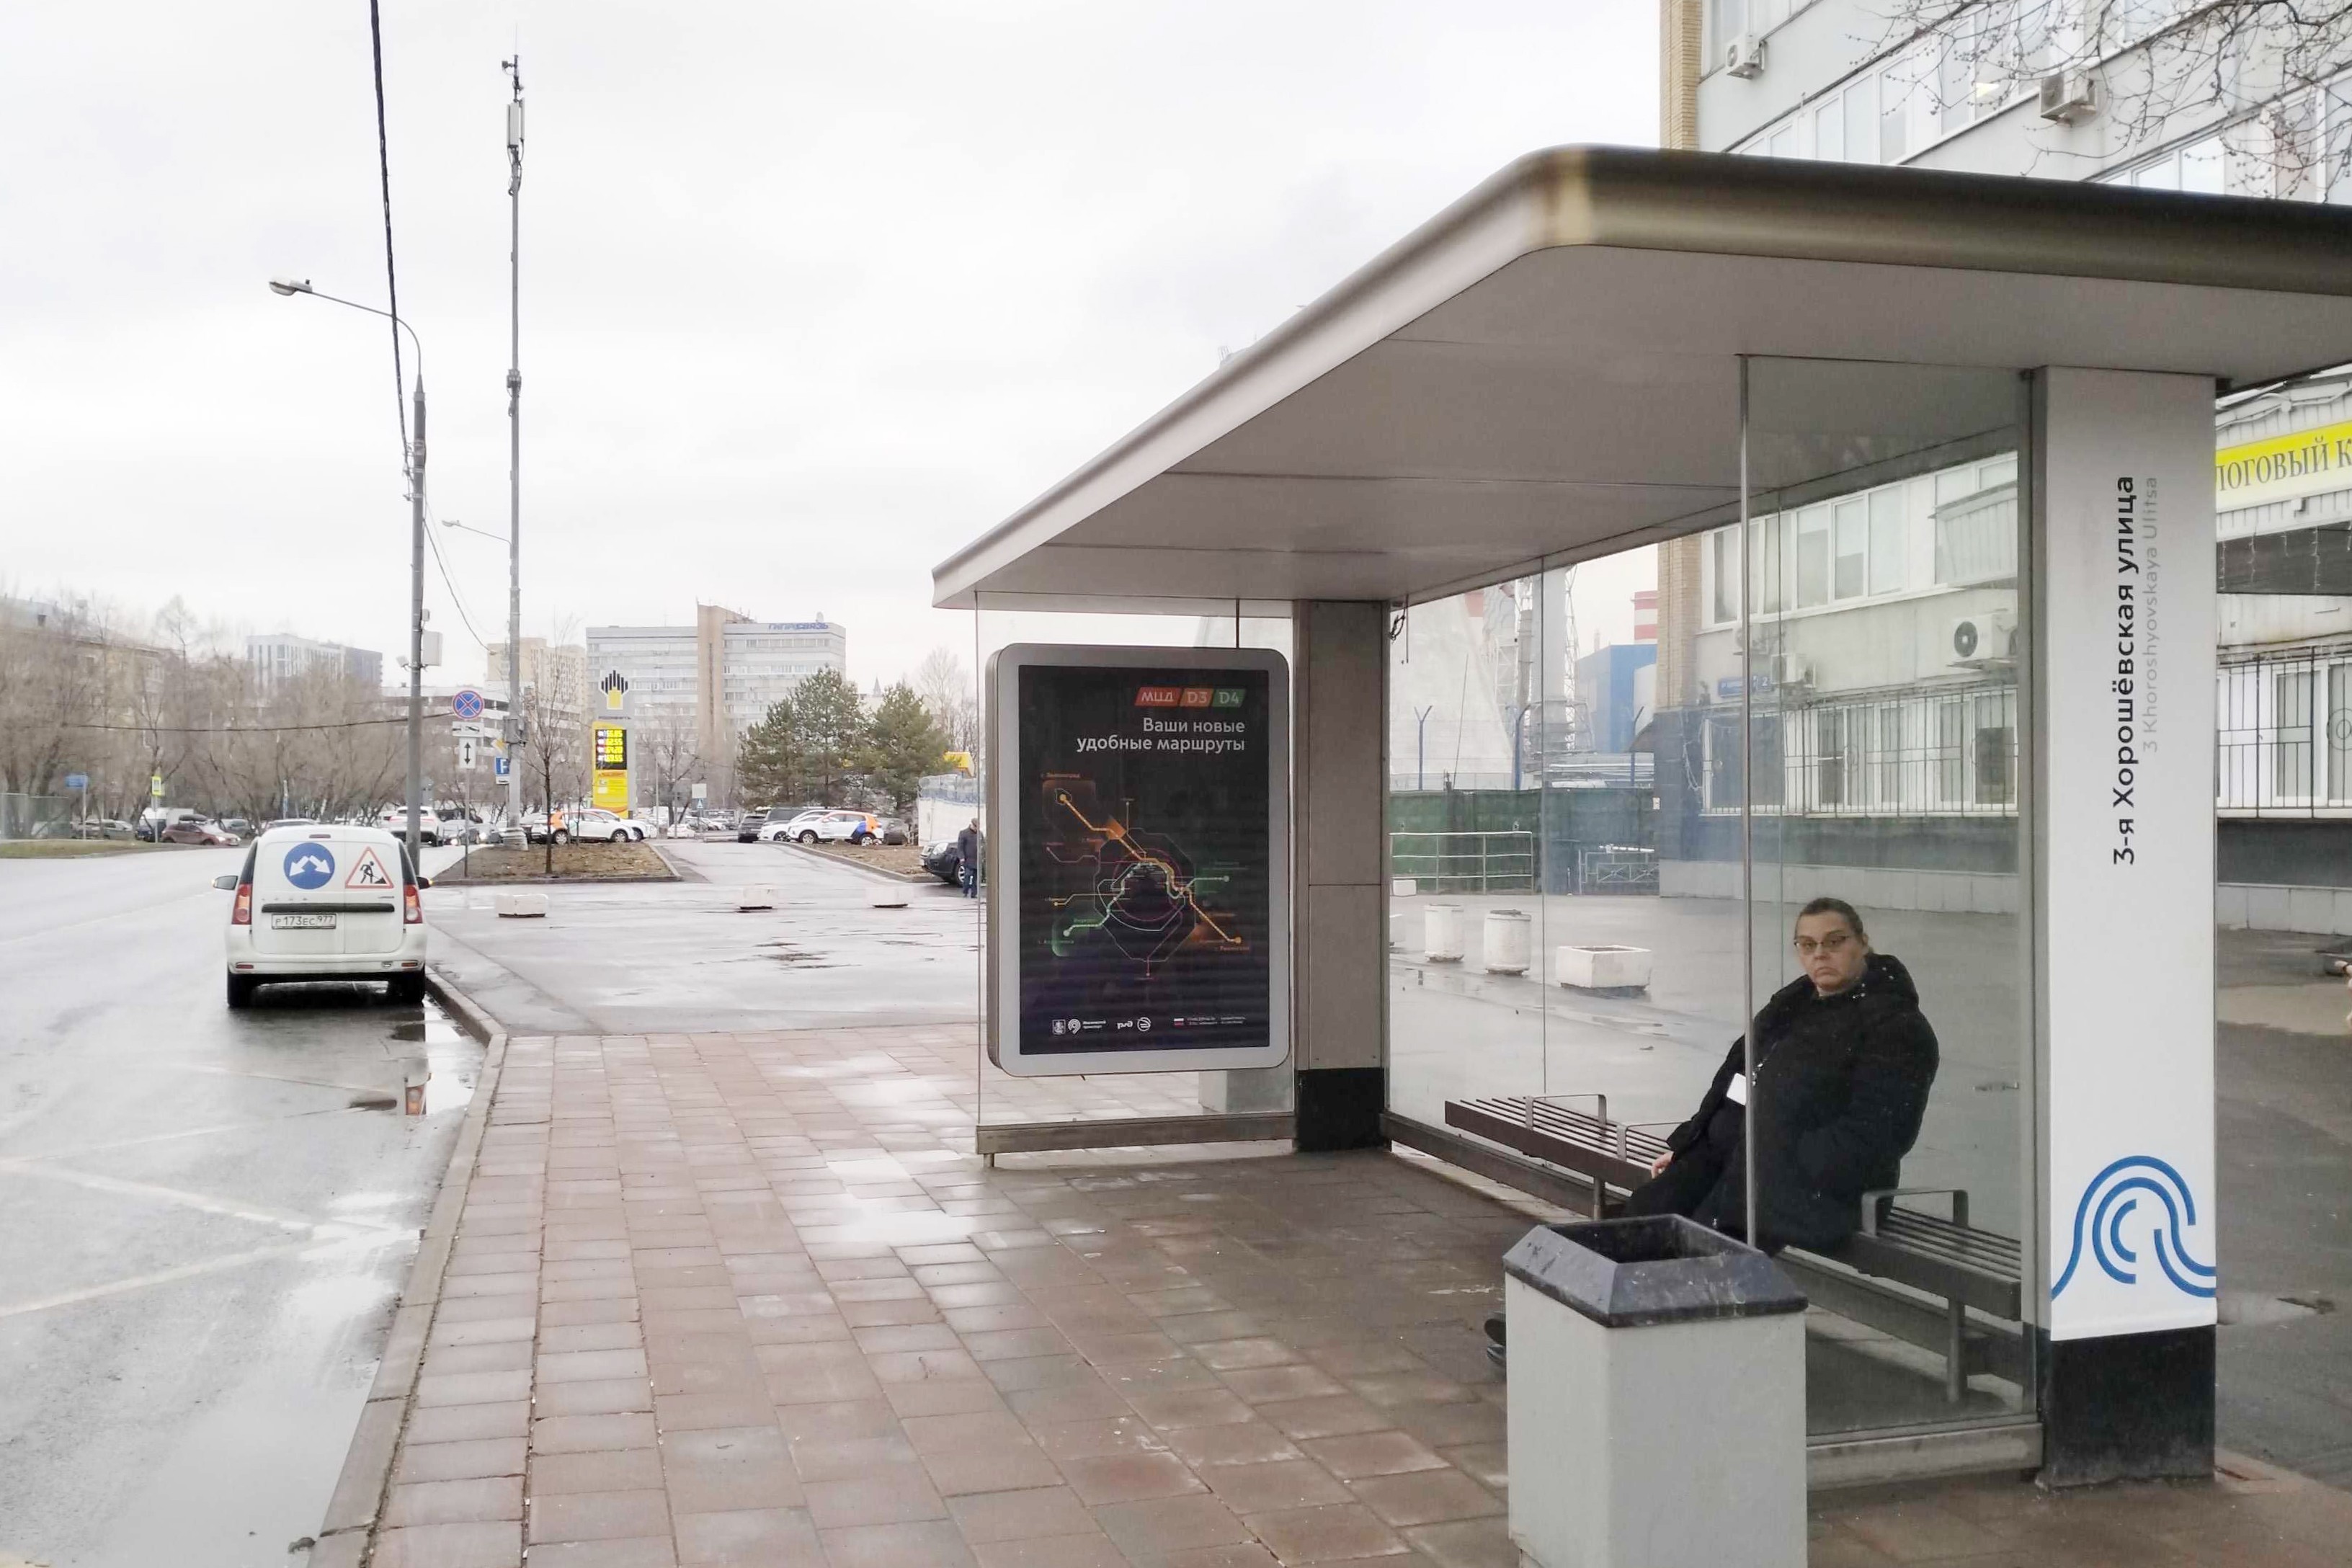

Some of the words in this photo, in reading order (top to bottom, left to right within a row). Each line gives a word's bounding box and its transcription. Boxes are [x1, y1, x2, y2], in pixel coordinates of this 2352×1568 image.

[2117, 476, 2139, 574] улица
[2143, 476, 2157, 539] Ulitsa
[2142, 547, 2161, 734] Khoroshyovskaya
[1141, 691, 1175, 703] МЦД
[1188, 692, 1207, 703] D3
[1219, 692, 1239, 704] D4
[2112, 584, 2139, 807] Хорошёвская
[1077, 735, 1152, 752] удобные
[1157, 739, 1245, 754] маршруты
[1143, 718, 1188, 733] Ваши
[1193, 721, 1245, 733] новые
[2143, 739, 2157, 752] 3
[2113, 819, 2134, 865] 3-я
